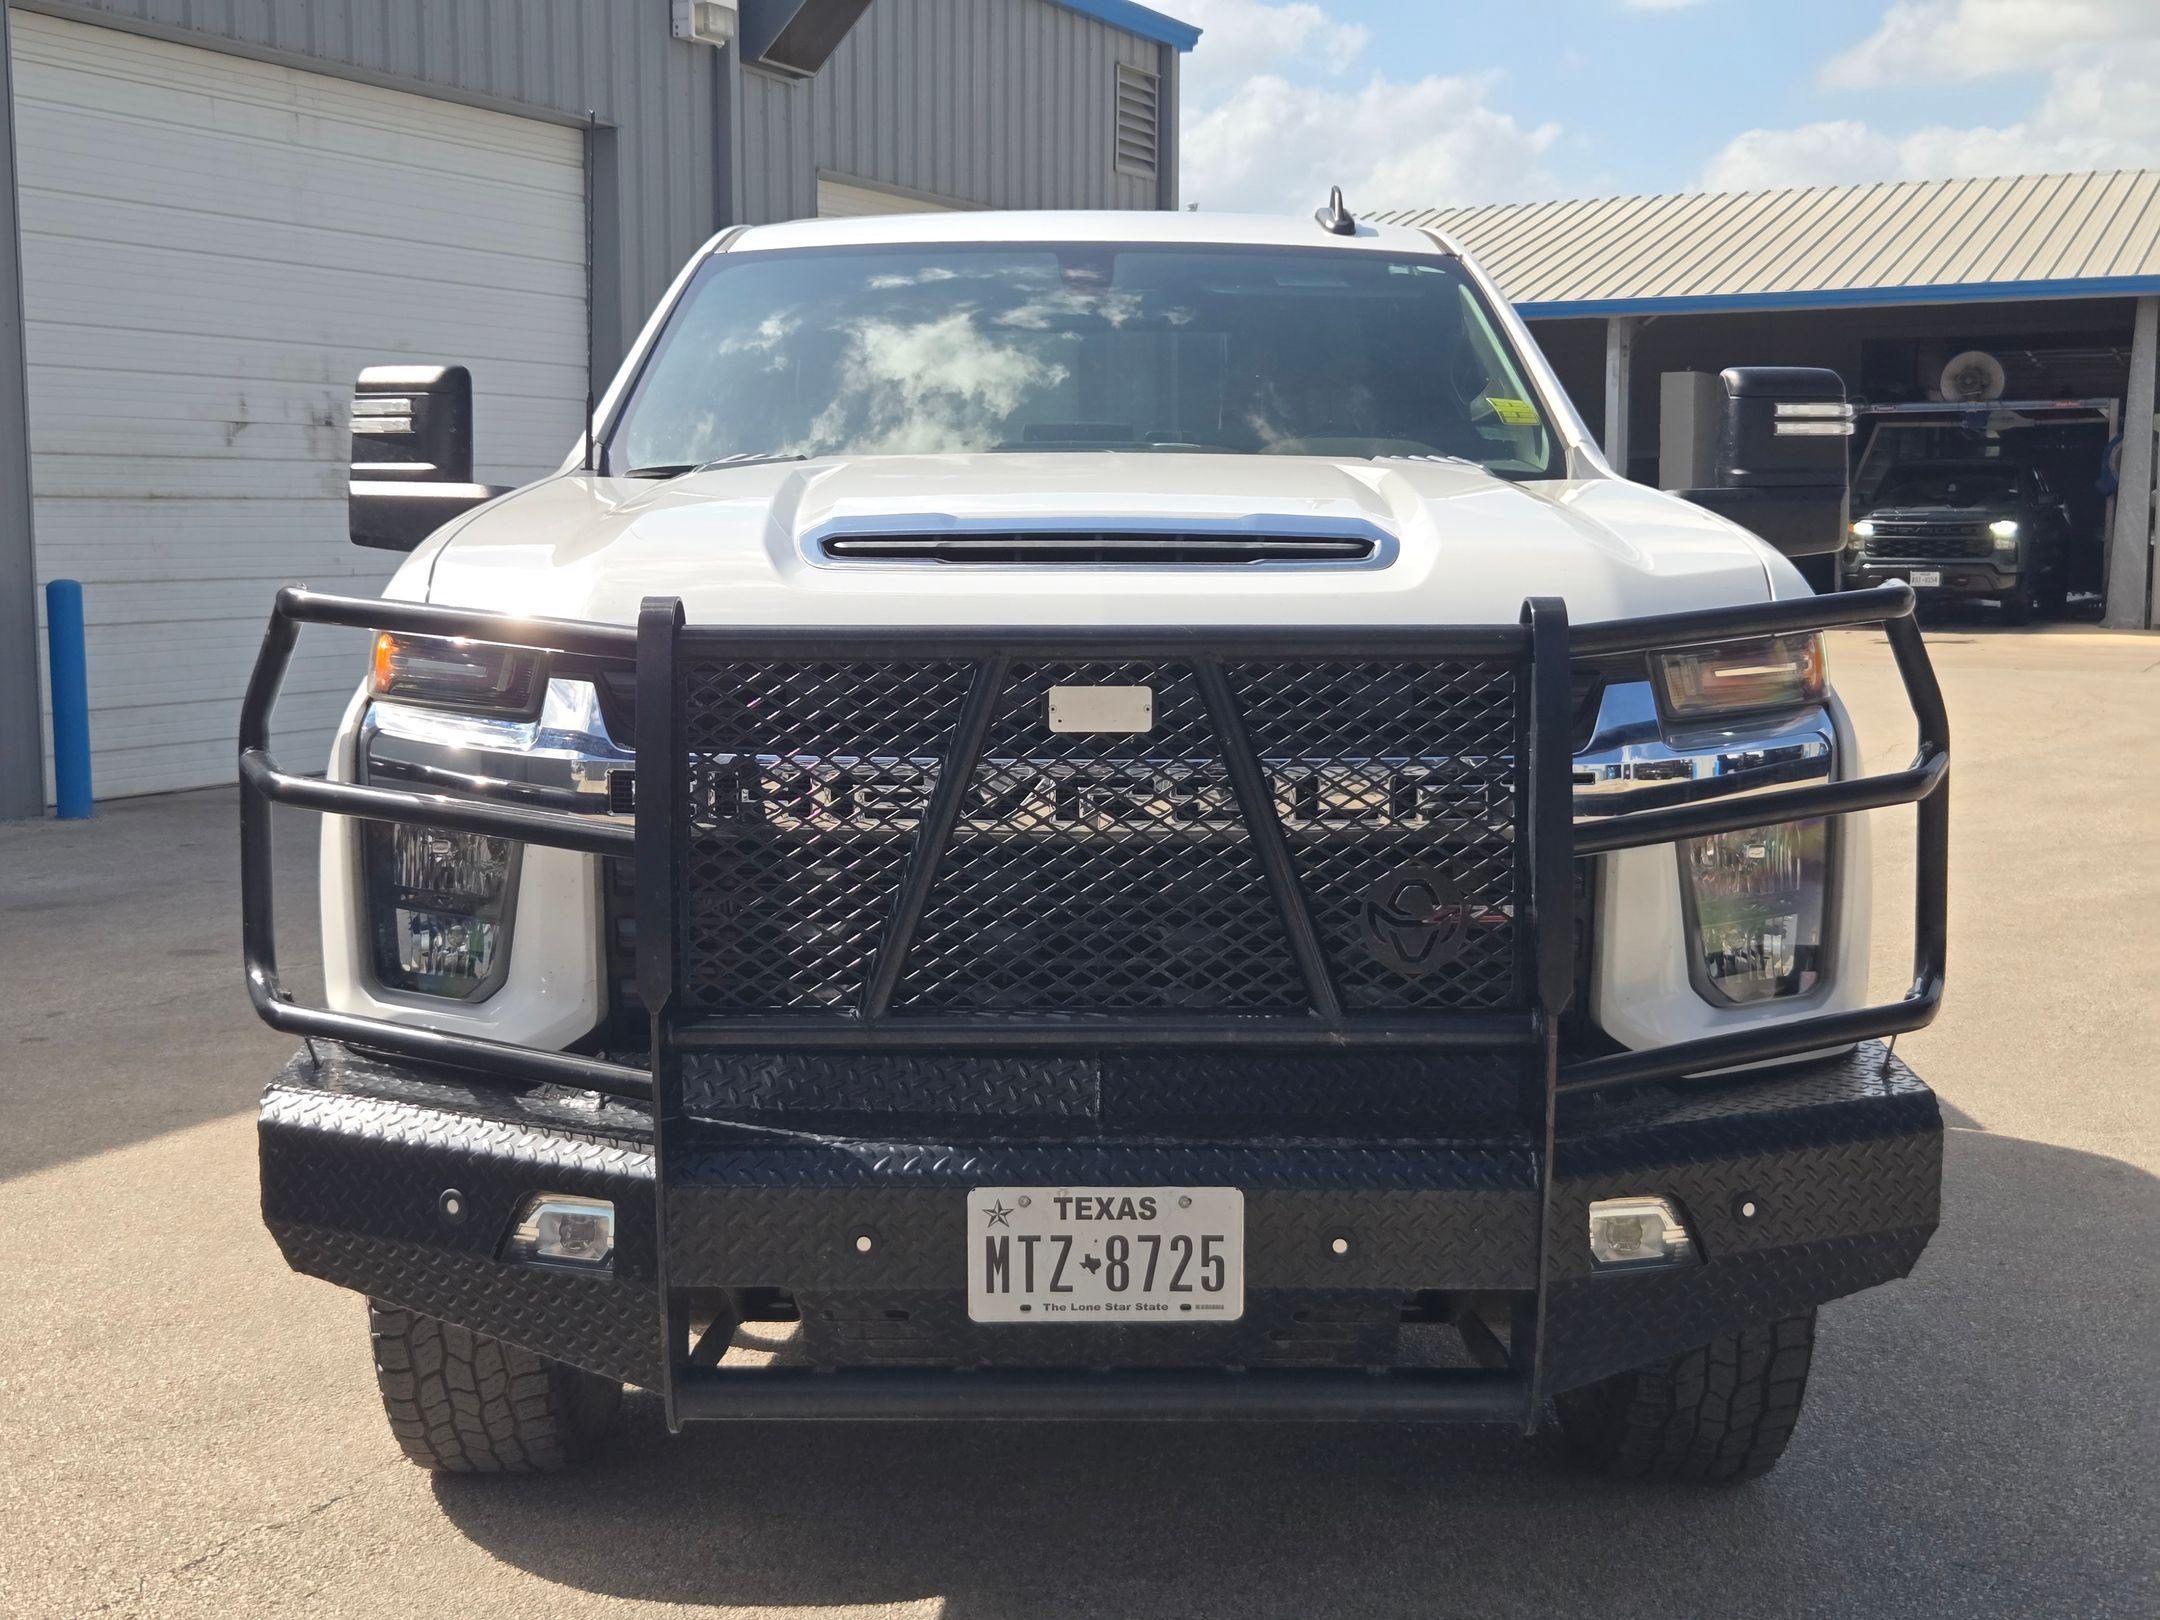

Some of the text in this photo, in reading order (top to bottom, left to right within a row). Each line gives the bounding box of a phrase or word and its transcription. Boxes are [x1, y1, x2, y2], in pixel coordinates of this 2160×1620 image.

[1053, 1196, 1157, 1221] TEXAS
[985, 1234, 1225, 1294] MTZ 8725
[1043, 1303, 1169, 1312] The Lone Star State
